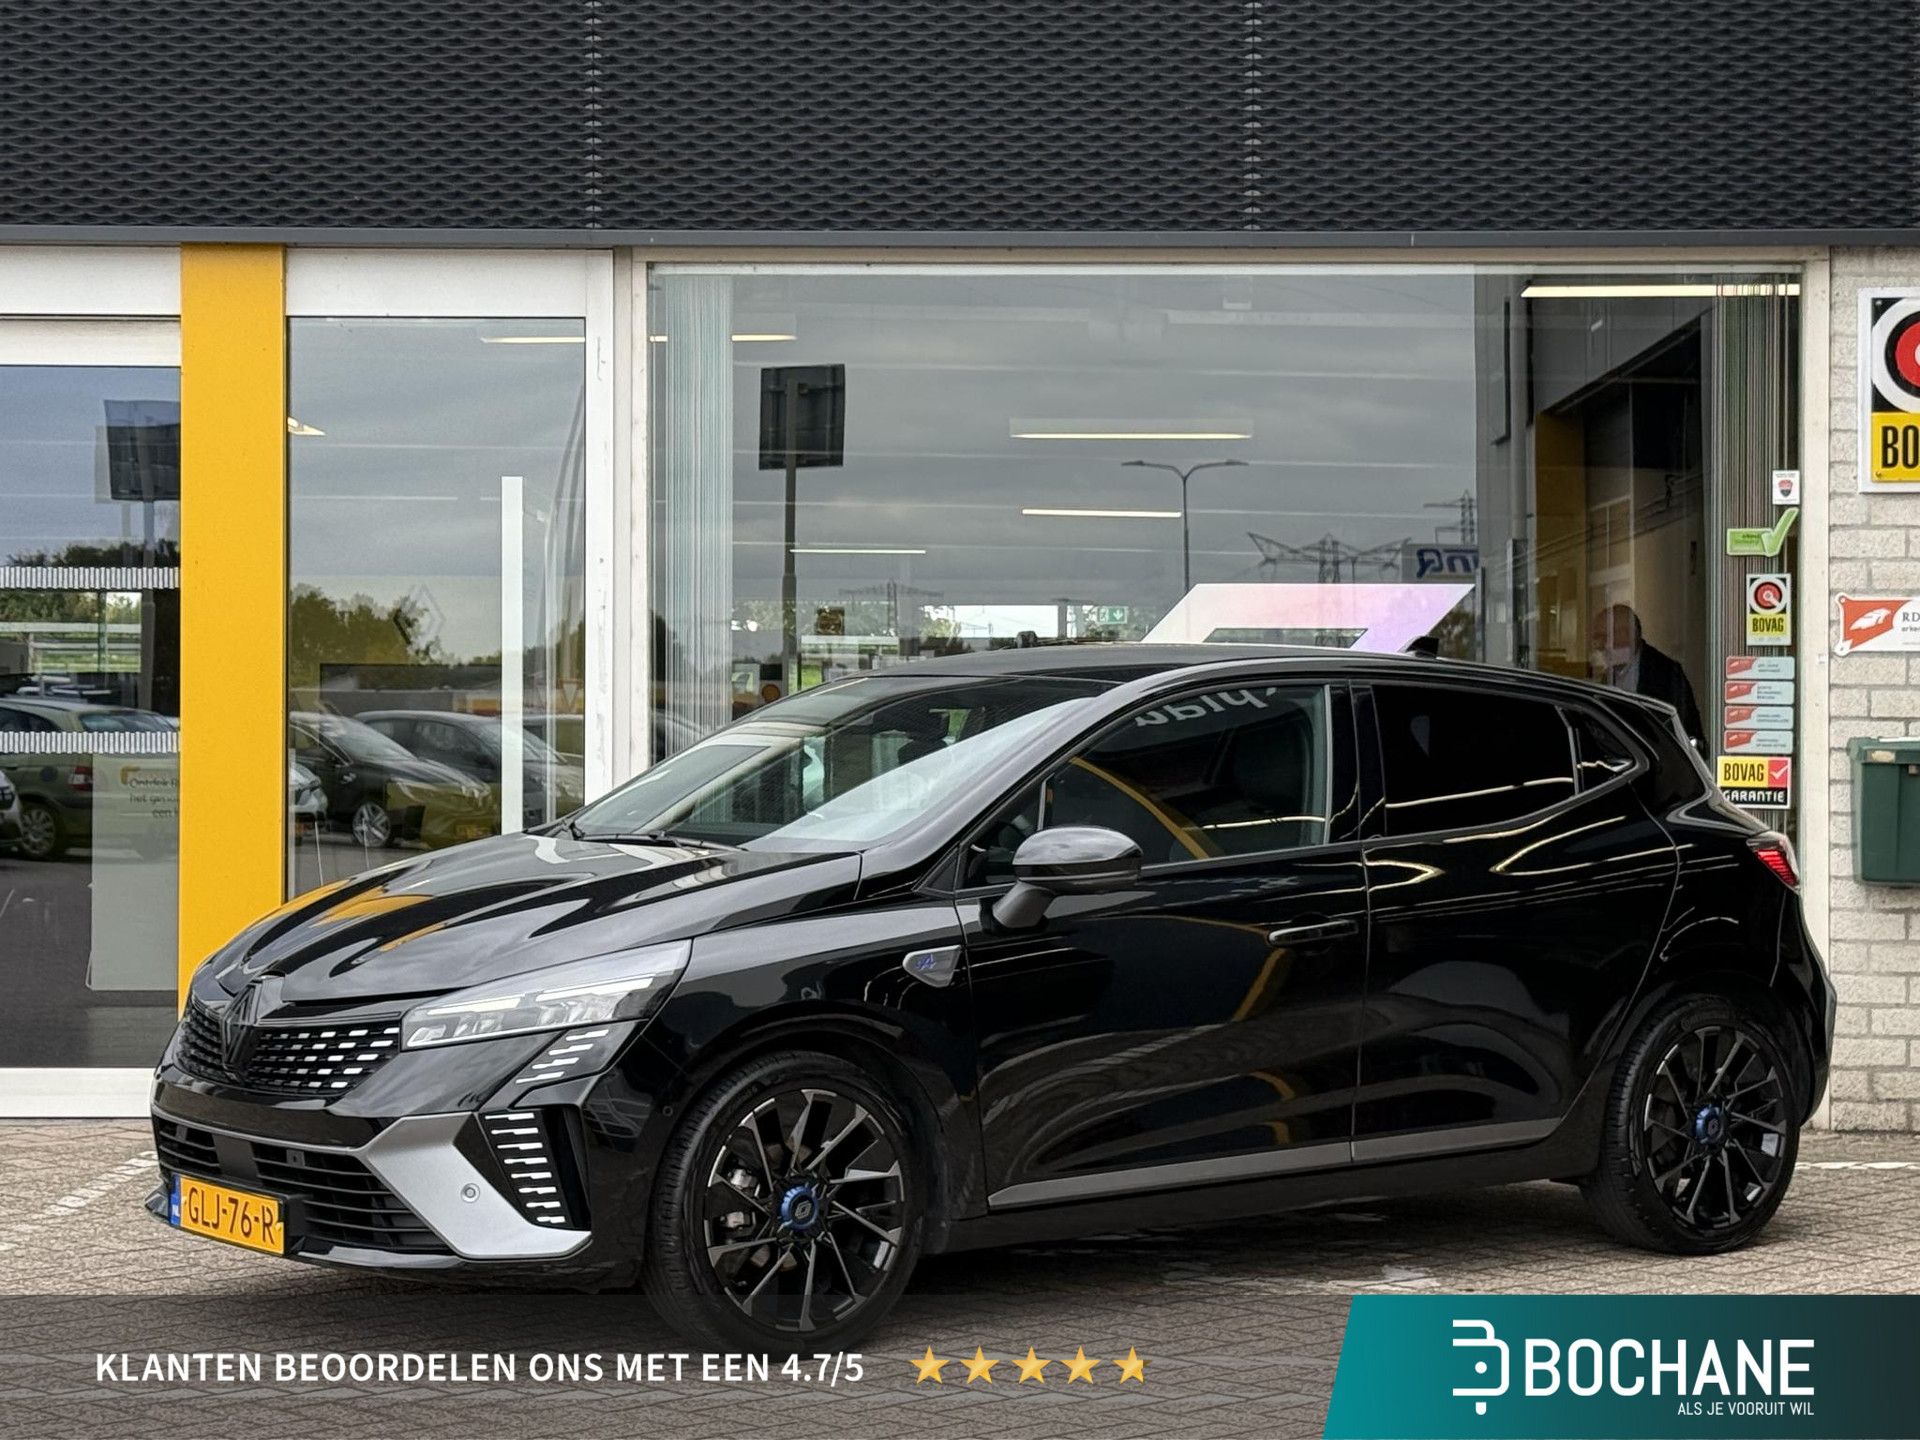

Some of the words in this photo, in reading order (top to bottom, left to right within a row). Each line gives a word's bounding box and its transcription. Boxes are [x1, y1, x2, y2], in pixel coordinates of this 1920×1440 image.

[1752, 617, 1784, 632] BOVAG
[1724, 763, 1764, 781] BOVAG
[1723, 790, 1785, 803] GARANTIE
[189, 1187, 275, 1244] GLJ-76-R
